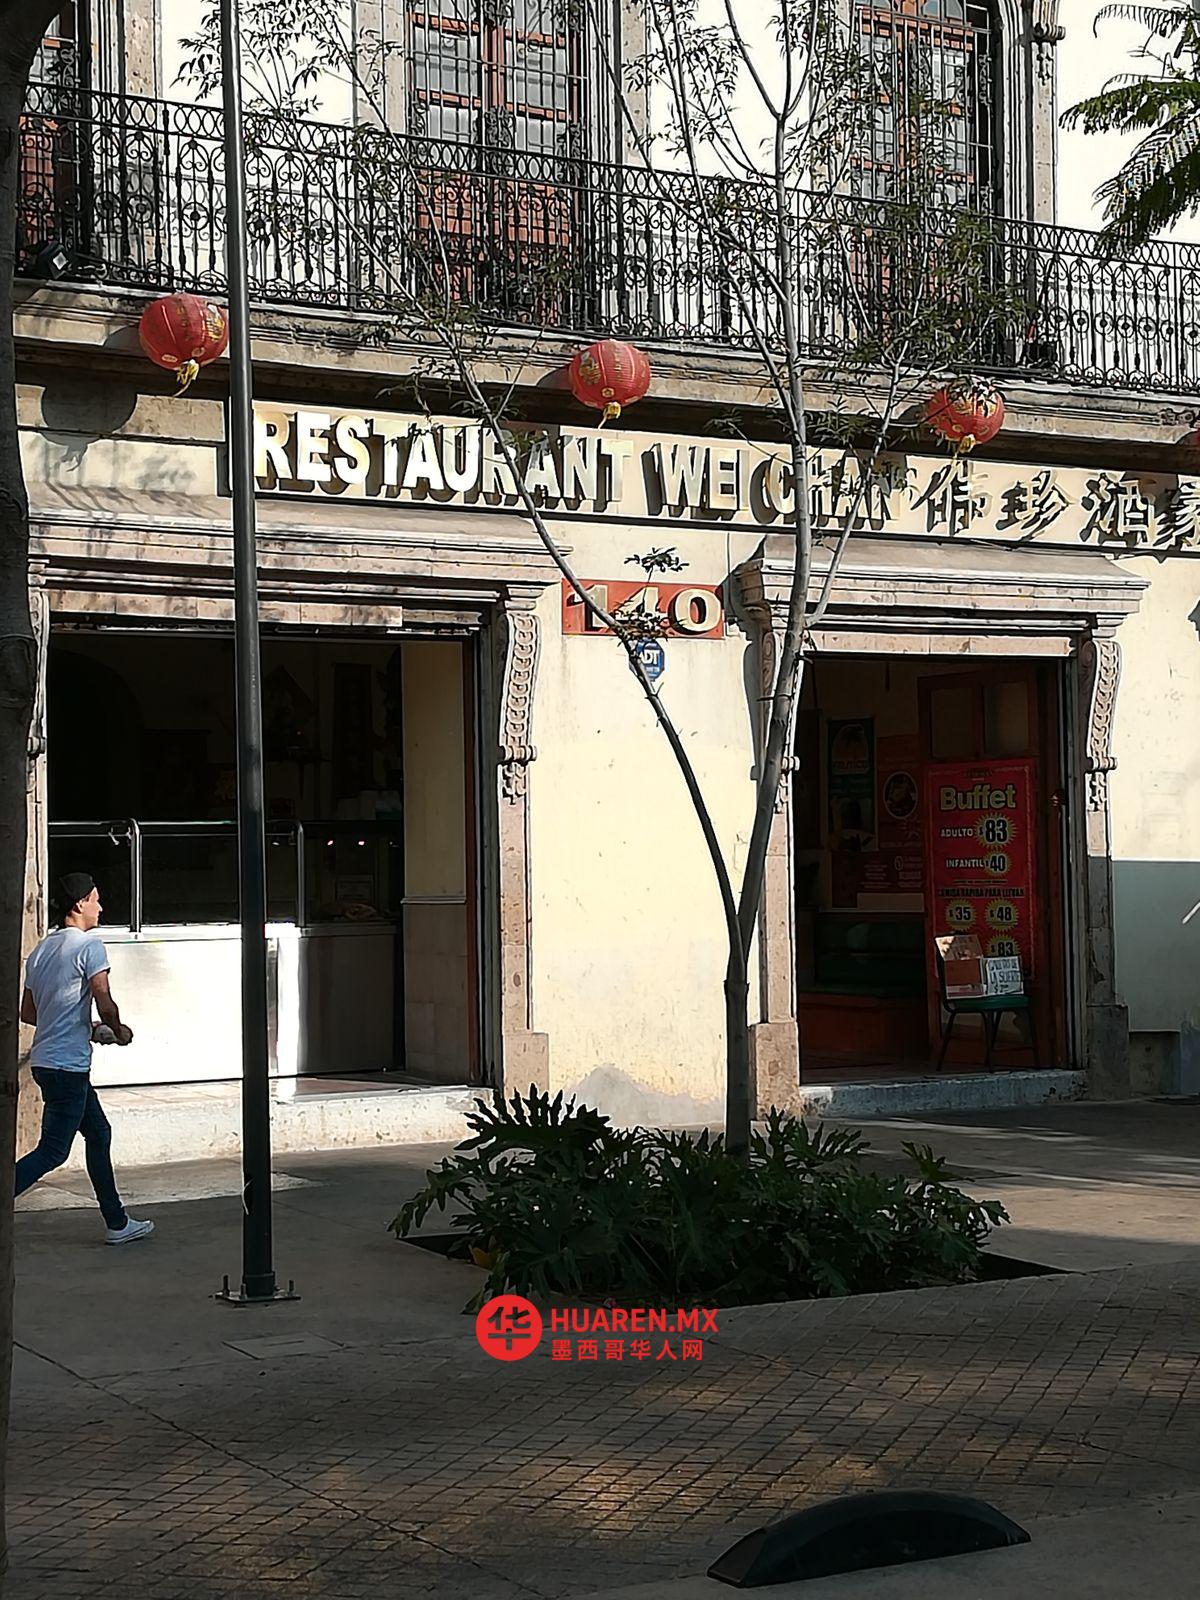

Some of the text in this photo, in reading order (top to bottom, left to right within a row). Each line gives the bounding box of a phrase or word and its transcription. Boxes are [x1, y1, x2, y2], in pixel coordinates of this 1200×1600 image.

[253, 411, 900, 520] RESTAURANT WEI CHAN
[566, 584, 721, 634] 140
[639, 649, 660, 665] ADT
[940, 784, 1016, 811] Buffet
[941, 827, 974, 838] ADULTO
[946, 858, 984, 868] INFANTIL
